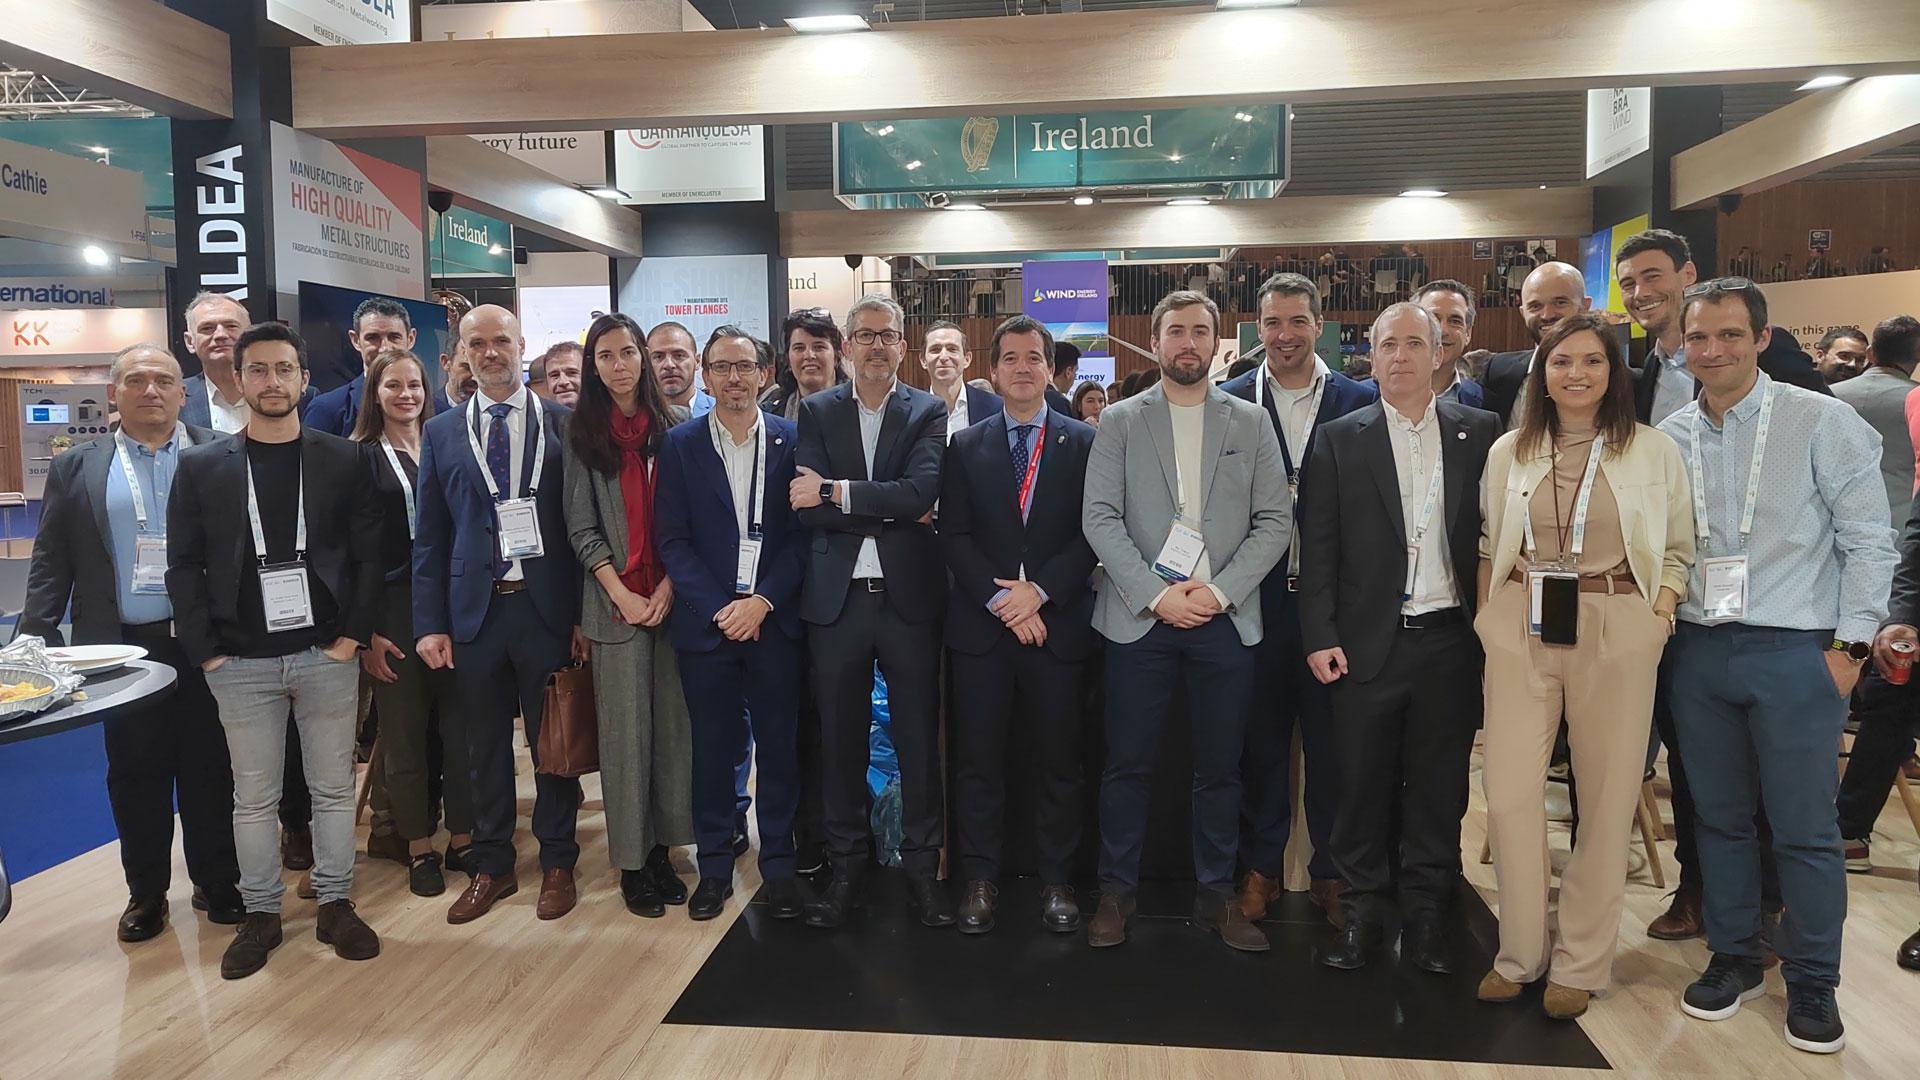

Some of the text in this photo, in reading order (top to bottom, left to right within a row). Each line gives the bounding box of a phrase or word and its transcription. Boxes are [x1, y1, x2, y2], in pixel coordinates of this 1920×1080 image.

[1613, 94, 1629, 115] BRA
[518, 132, 577, 150] future
[1031, 114, 1154, 152] Ireland
[1, 163, 48, 195] Cathie
[289, 159, 364, 195] MANUFACTURE OF
[291, 182, 392, 232] HIGH QUALITY
[321, 223, 410, 260] METAL STRUCTURES
[447, 216, 489, 247] Ireland
[0, 284, 105, 306] ernational
[1046, 289, 1077, 299] WIND
[664, 304, 692, 316] TOWER
[694, 303, 729, 316] FLANGES
[1789, 326, 1800, 336] in
[1802, 324, 1825, 336] this
